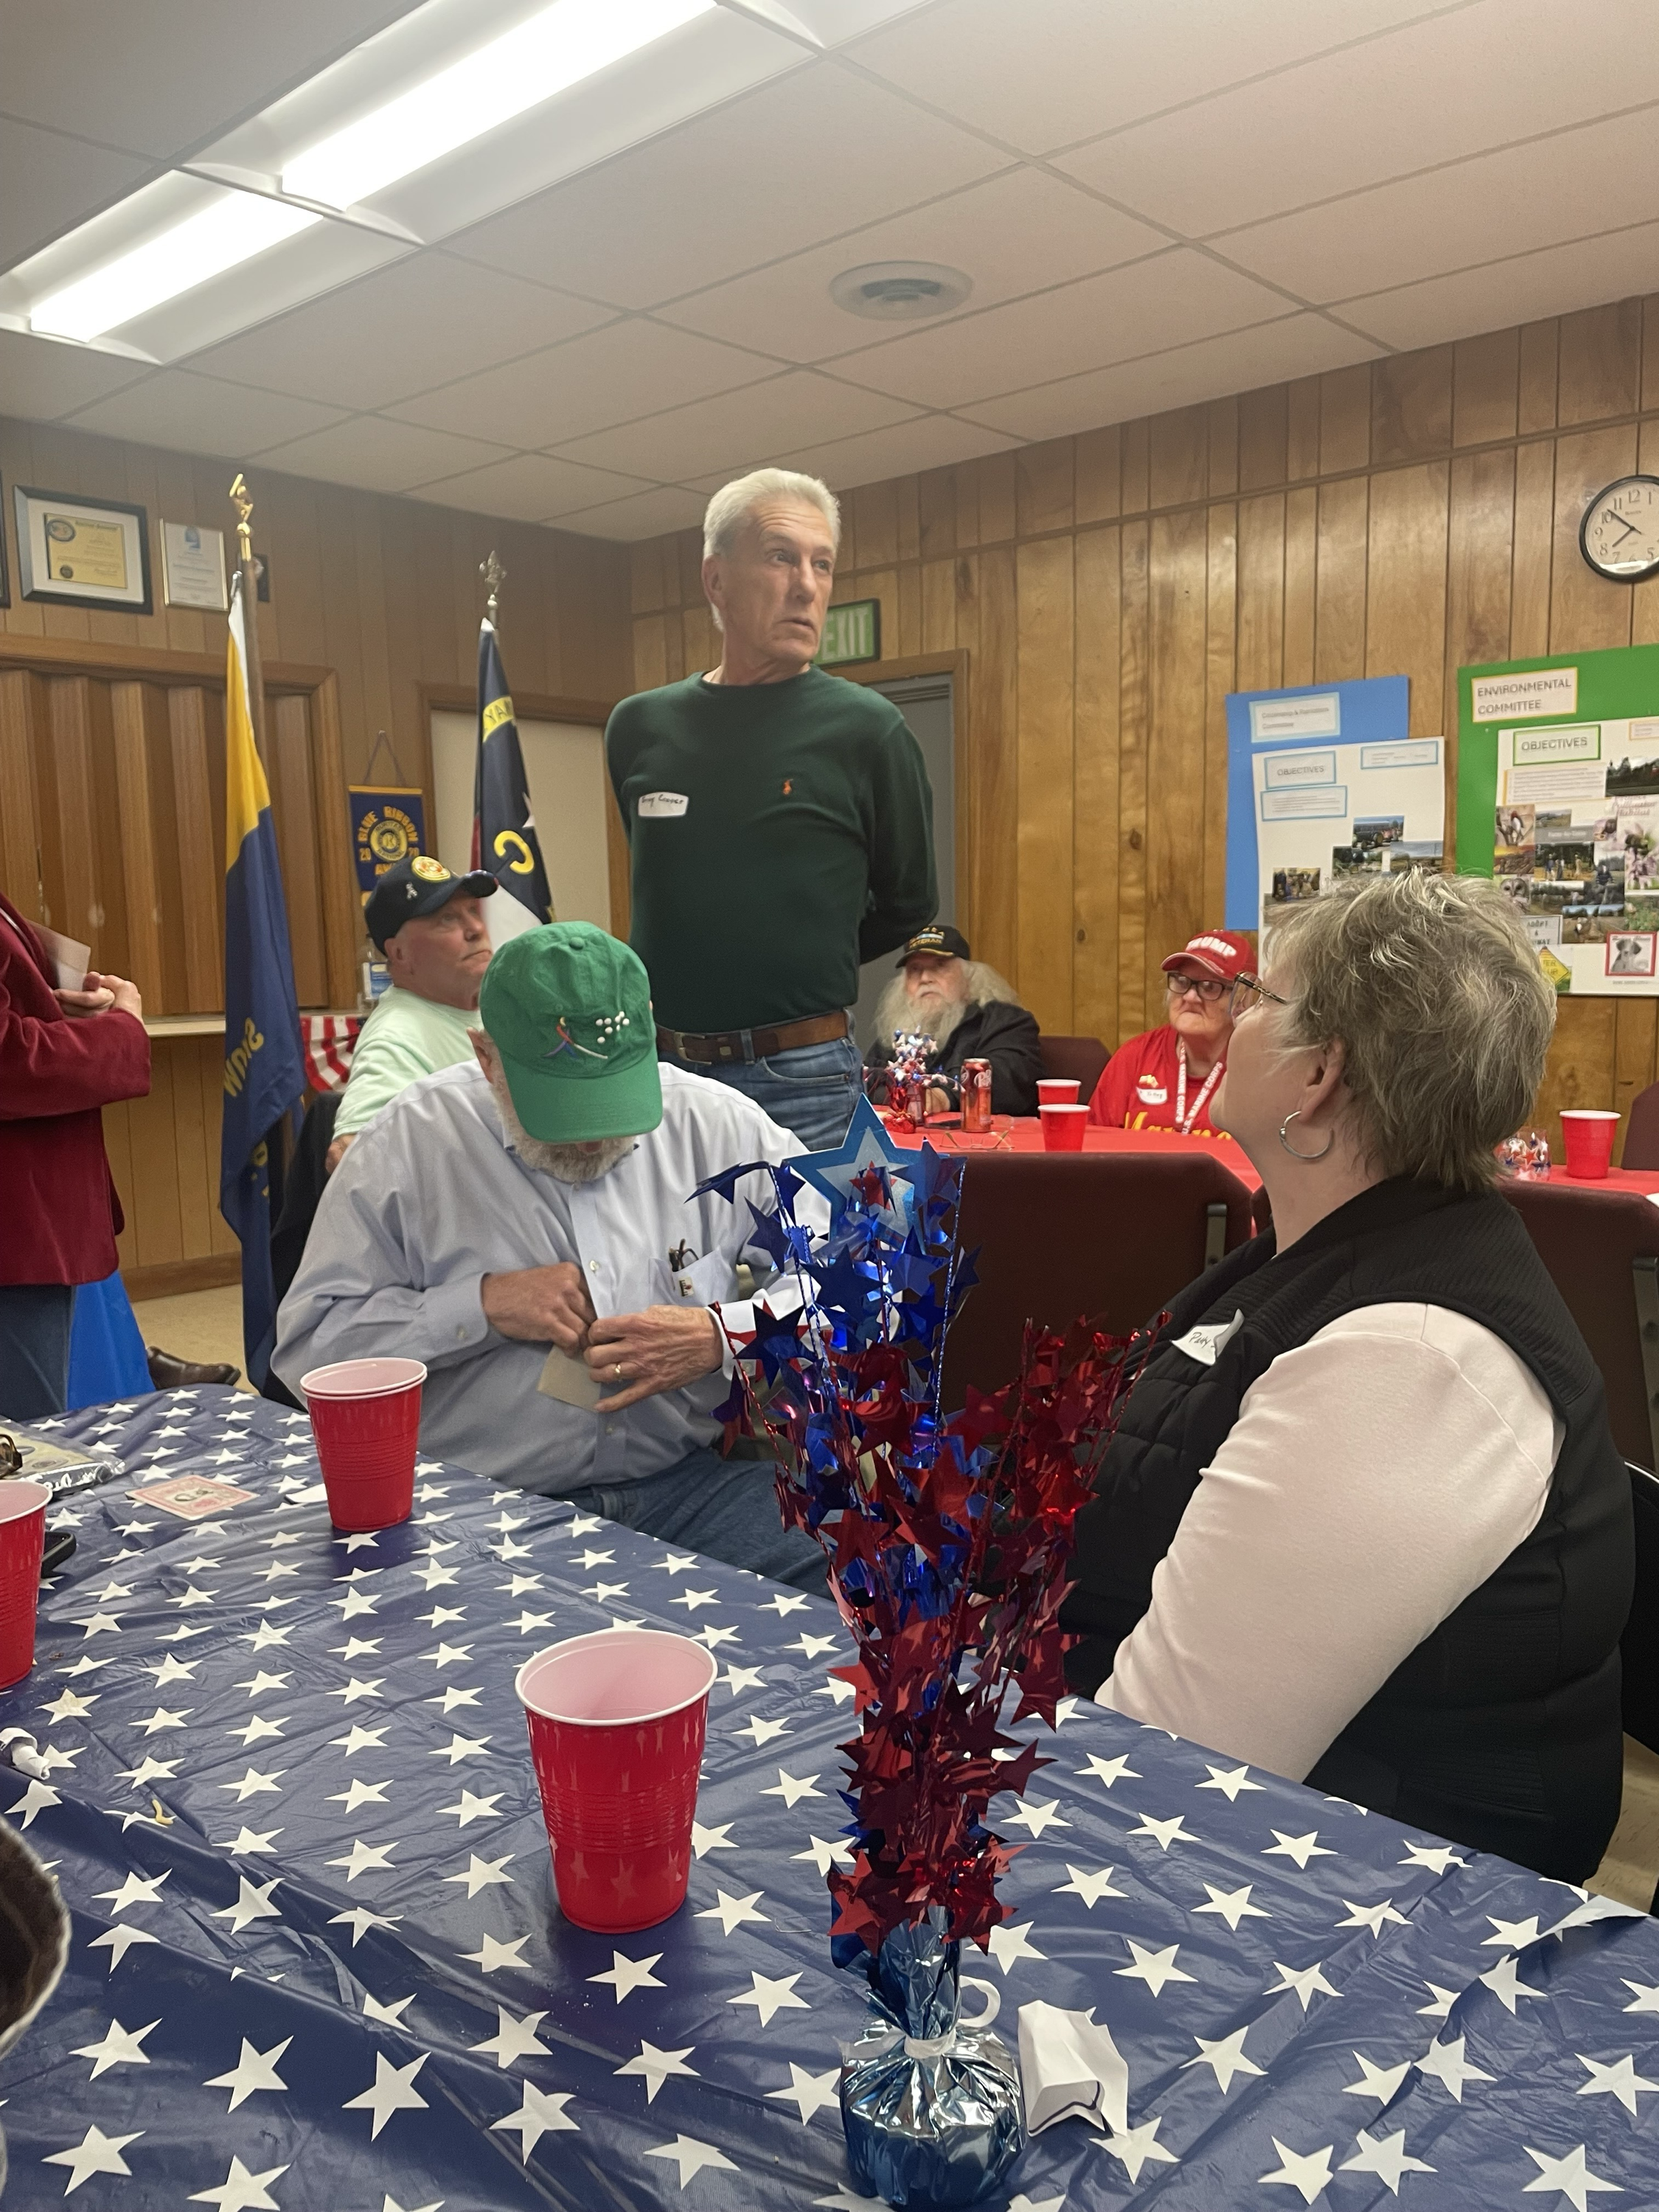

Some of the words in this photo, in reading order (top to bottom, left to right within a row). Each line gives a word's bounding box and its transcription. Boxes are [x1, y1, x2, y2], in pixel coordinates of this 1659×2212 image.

[1613, 497, 1623, 510] 11
[1628, 489, 1641, 504] 12
[1648, 491, 1652, 505] 1
[1601, 510, 1613, 524] 10
[1594, 526, 1604, 540] 9
[1599, 543, 1608, 556] 8
[1612, 551, 1621, 563] 7
[1477, 678, 1572, 697] ENVIRONMENTAL
[1477, 698, 1542, 714] COMMITTEE
[1521, 736, 1588, 751] OBJECTIVES
[1276, 765, 1325, 776] OBJECTIVES
[357, 810, 379, 842] BLUE
[383, 805, 419, 842] RIBBON
[359, 847, 372, 862] 20
[1185, 936, 1237, 957] TRUMP
[1177, 1062, 1186, 1094] MARINE
[1188, 1088, 1210, 1119] MARINE
[1204, 1061, 1224, 1089] CORPS
[1175, 1095, 1186, 1123] CORPS
